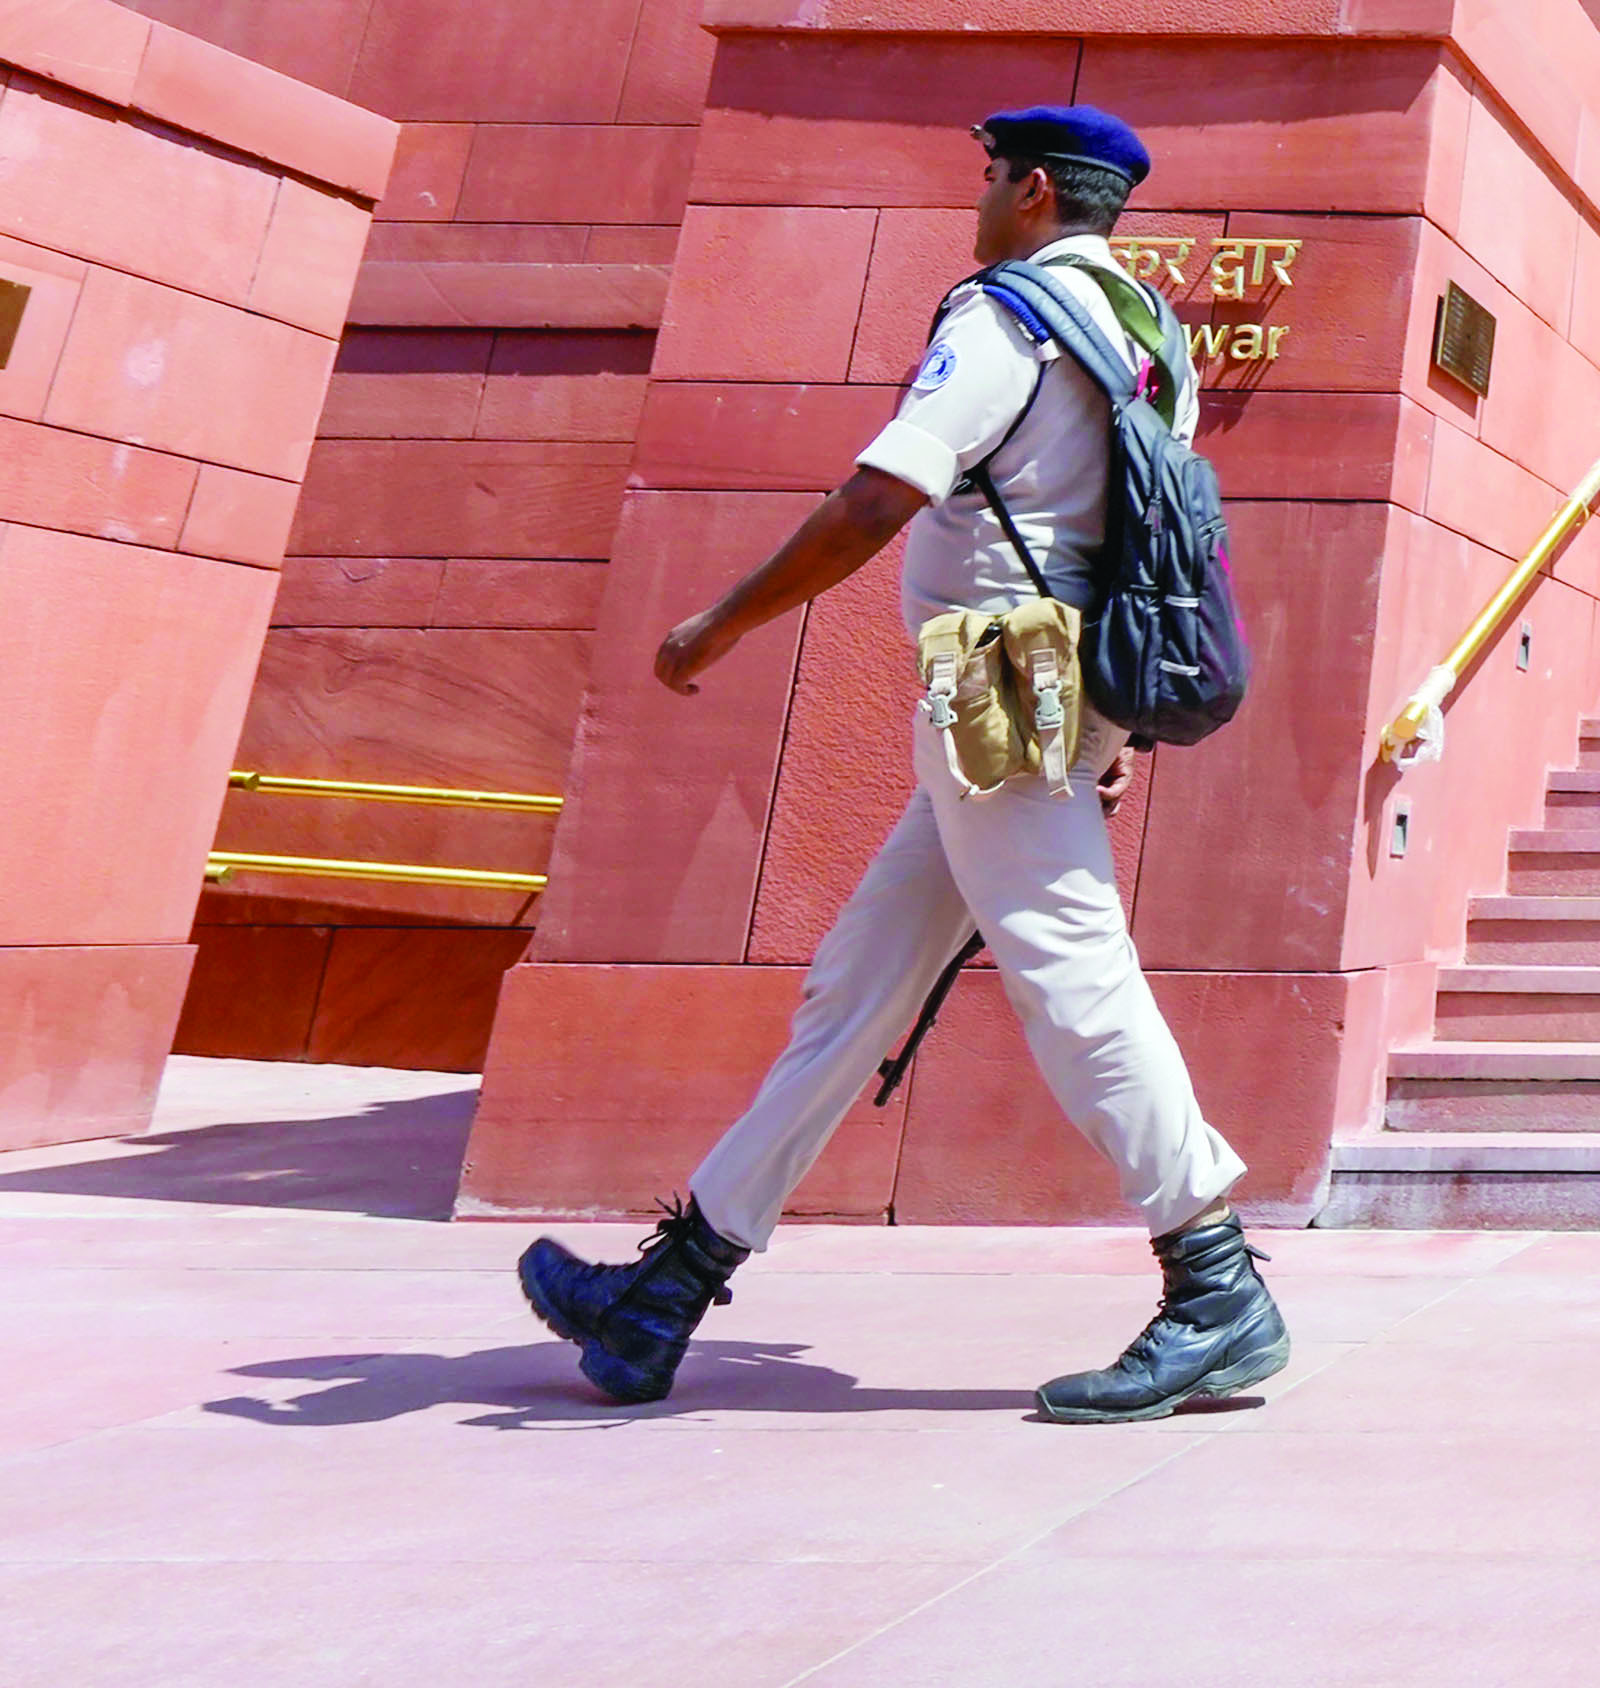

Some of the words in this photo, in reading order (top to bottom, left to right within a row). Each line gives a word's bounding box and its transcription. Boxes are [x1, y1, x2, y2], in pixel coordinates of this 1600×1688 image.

[1108, 236, 1195, 285] कर
[1211, 238, 1303, 300] द्वार
[1181, 323, 1290, 360] war
